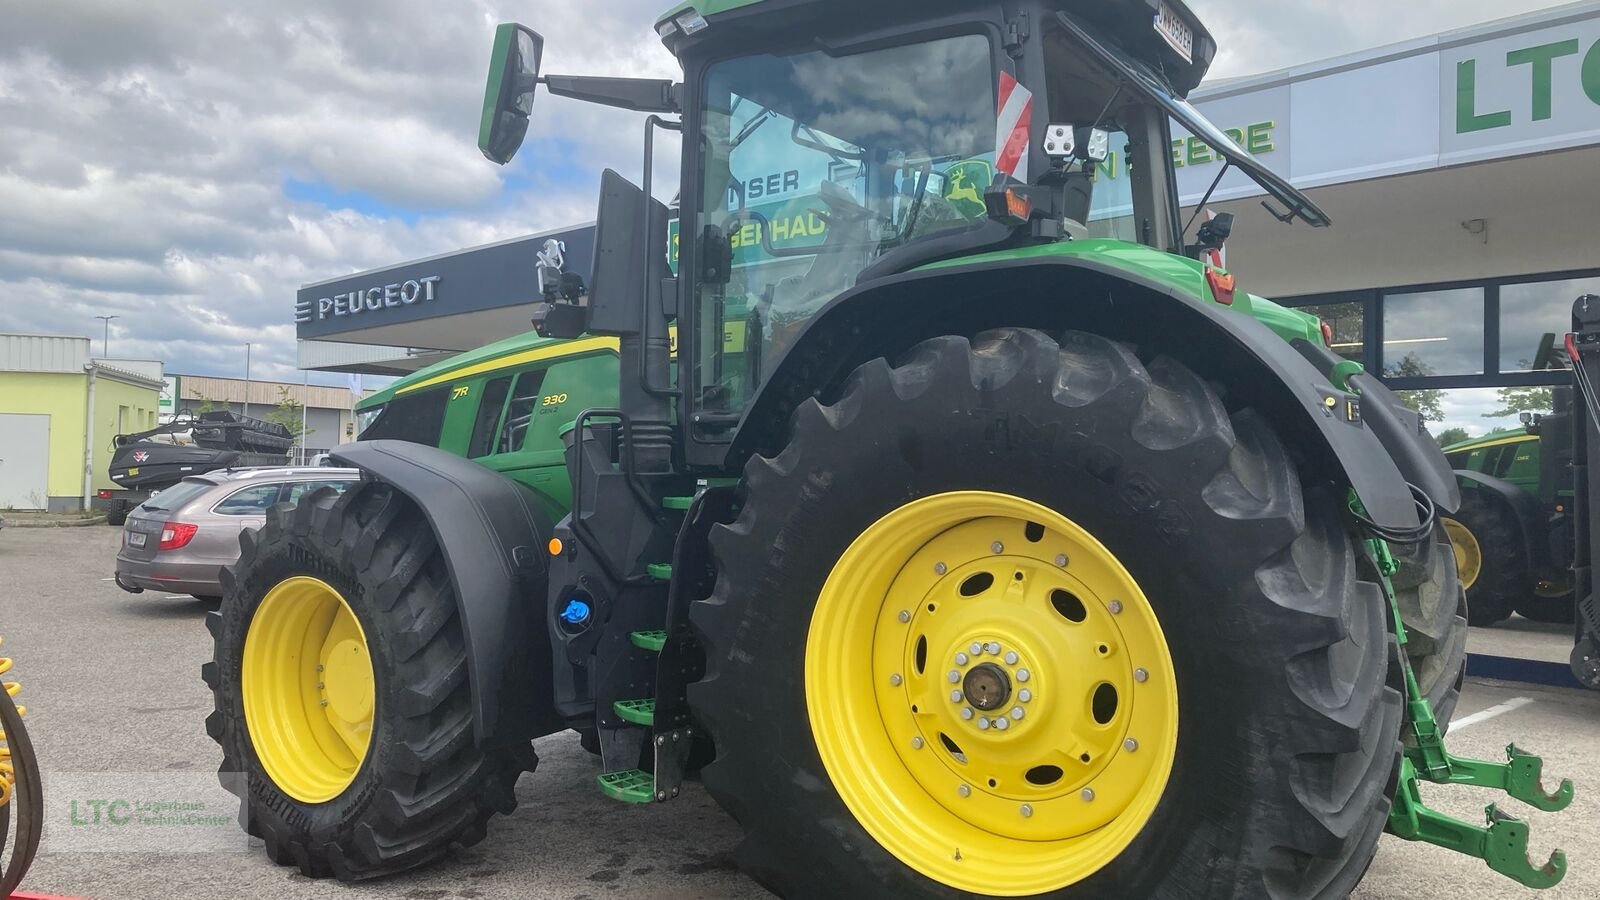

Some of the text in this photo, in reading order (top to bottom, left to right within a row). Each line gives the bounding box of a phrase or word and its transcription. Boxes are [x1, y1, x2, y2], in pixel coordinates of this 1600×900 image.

[1456, 38, 1600, 134] LT
[318, 275, 441, 320] PEUGEOT
[452, 386, 469, 400] 7R
[542, 393, 568, 406] 330
